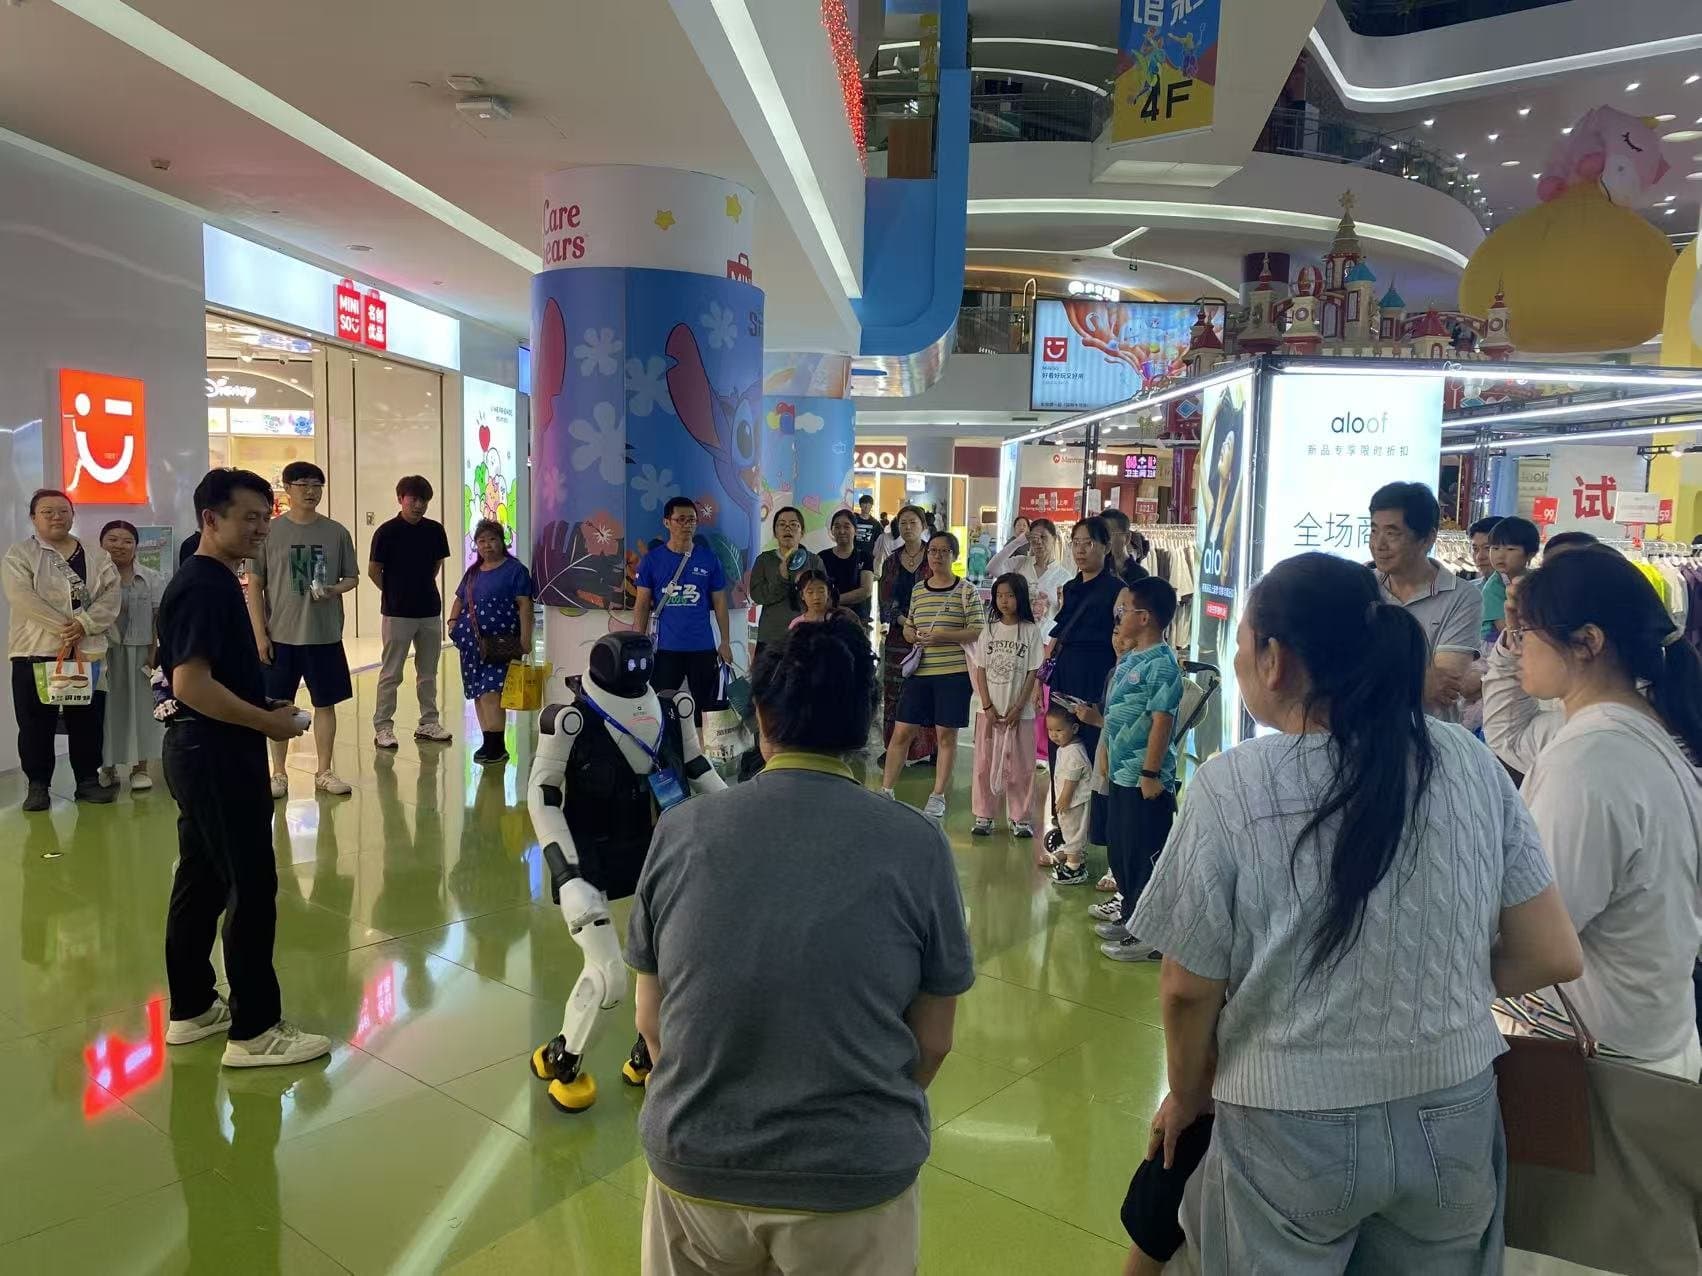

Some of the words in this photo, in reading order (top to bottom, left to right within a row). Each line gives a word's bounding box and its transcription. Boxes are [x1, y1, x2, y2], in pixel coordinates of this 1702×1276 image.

[1140, 75, 1193, 121] 4F
[543, 199, 581, 235] Care
[339, 294, 361, 317] MINI
[1331, 410, 1388, 434] aloof
[1307, 444, 1409, 457] 新品专享限时折扣
[1572, 475, 1617, 521] 试
